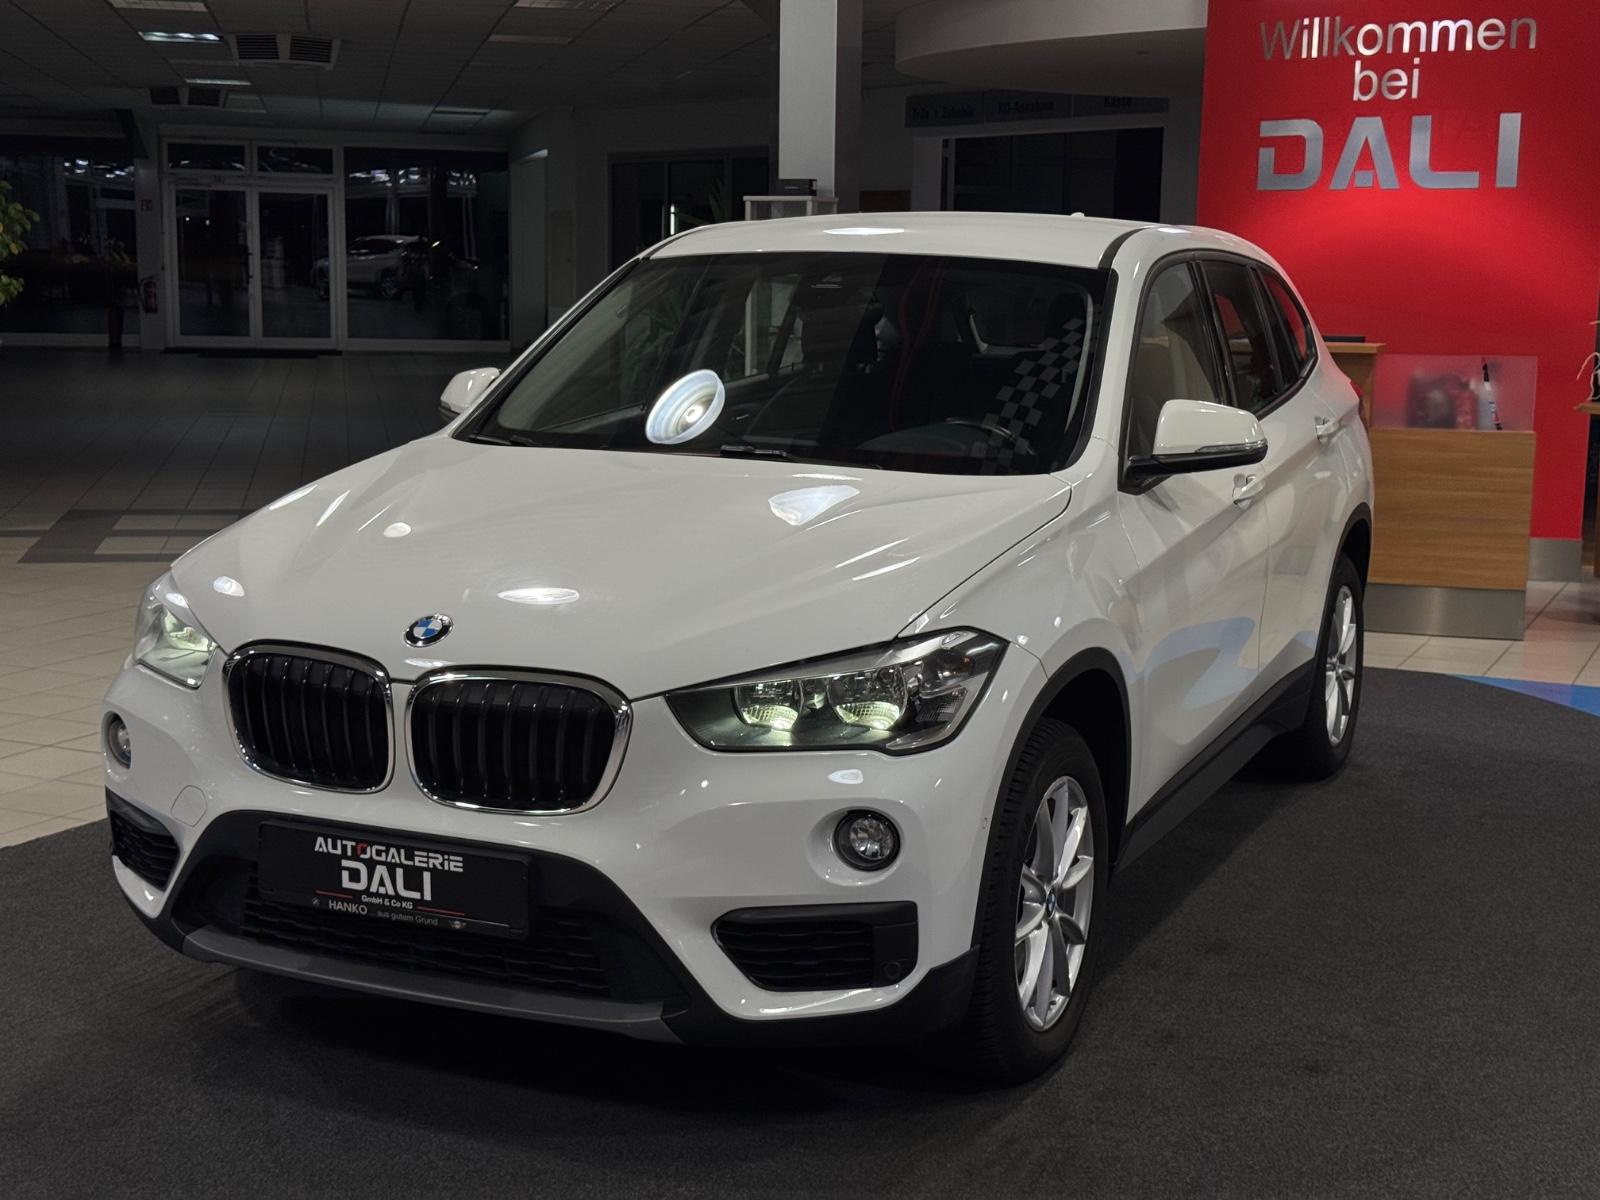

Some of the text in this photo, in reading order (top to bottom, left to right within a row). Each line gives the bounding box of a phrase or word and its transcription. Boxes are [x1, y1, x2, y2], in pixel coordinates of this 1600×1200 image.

[1260, 16, 1537, 60] Willkommen
[1353, 58, 1421, 101] bei
[1257, 112, 1522, 190] DALI
[341, 859, 432, 901] DALI
[328, 899, 368, 915] HANKO
[361, 894, 382, 905] GmbH
[401, 900, 413, 910] KG
